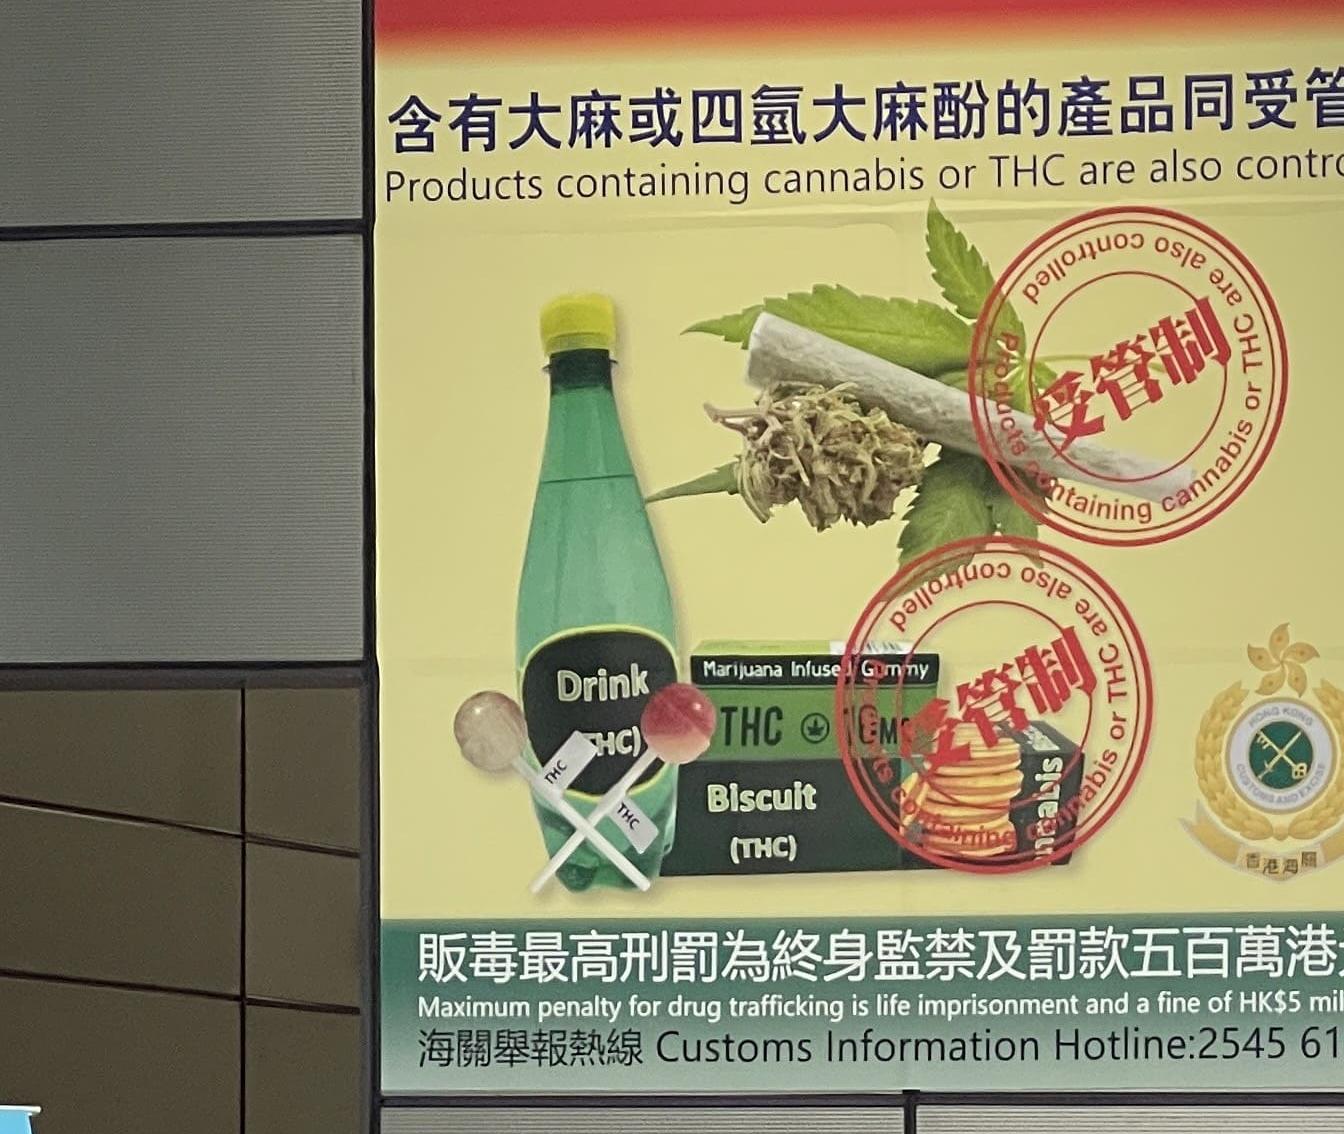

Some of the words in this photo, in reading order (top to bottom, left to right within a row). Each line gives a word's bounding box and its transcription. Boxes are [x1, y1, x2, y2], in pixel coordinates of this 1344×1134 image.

[385, 168, 542, 203] Products
[557, 162, 749, 205] containing
[764, 156, 924, 195] cannabis
[939, 162, 977, 190] or
[988, 153, 1066, 188] THC
[1079, 157, 1136, 186] are
[1150, 148, 1222, 183] also
[1021, 232, 1145, 305] controlled
[1154, 233, 1207, 270] also
[1208, 267, 1243, 306] are
[1233, 313, 1263, 374] THC
[994, 331, 1028, 457] Products
[1032, 296, 1232, 458] 受管制
[1245, 380, 1262, 411] or
[1161, 419, 1254, 512] cannabis
[1023, 460, 1153, 524] containing
[889, 562, 1011, 633] controlled
[1020, 566, 1073, 599] also
[1074, 597, 1108, 637] are
[557, 662, 650, 702] Drink
[703, 660, 782, 680] Marijuana
[861, 659, 929, 681] Gmmy
[1099, 642, 1128, 704] THC
[900, 625, 1097, 784] 受管制
[1248, 706, 1280, 728] HONG
[1283, 706, 1314, 727] KONG
[582, 725, 642, 757] THC)
[720, 705, 783, 746] THC
[1109, 711, 1127, 741] or
[544, 759, 568, 785] THC
[1236, 763, 1275, 804] CUSTOMS
[1276, 793, 1299, 804] AND
[1299, 763, 1326, 799] EXCISE
[616, 801, 641, 830] THC
[706, 782, 817, 813] Biscuit
[729, 835, 798, 865] (THC)
[1246, 851, 1318, 875] 香港海關
[418, 995, 530, 1018] Maximum
[538, 994, 622, 1022] penalty
[627, 994, 662, 1018] for
[667, 994, 722, 1022] drug
[728, 993, 844, 1022] trafficking
[851, 993, 870, 1016] is
[876, 992, 911, 1016] life
[918, 992, 1080, 1021] imprisonment
[1085, 991, 1129, 1015] and
[1136, 997, 1150, 1014] a
[1157, 990, 1201, 1014] fine
[1208, 990, 1233, 1014] of
[1240, 989, 1301, 1015] HK$5
[418, 1028, 644, 1068] 海關舉報熱線
[656, 1030, 812, 1064] Customs
[826, 1027, 1039, 1063] Information
[1055, 1026, 1286, 1061] Hotline:2545
